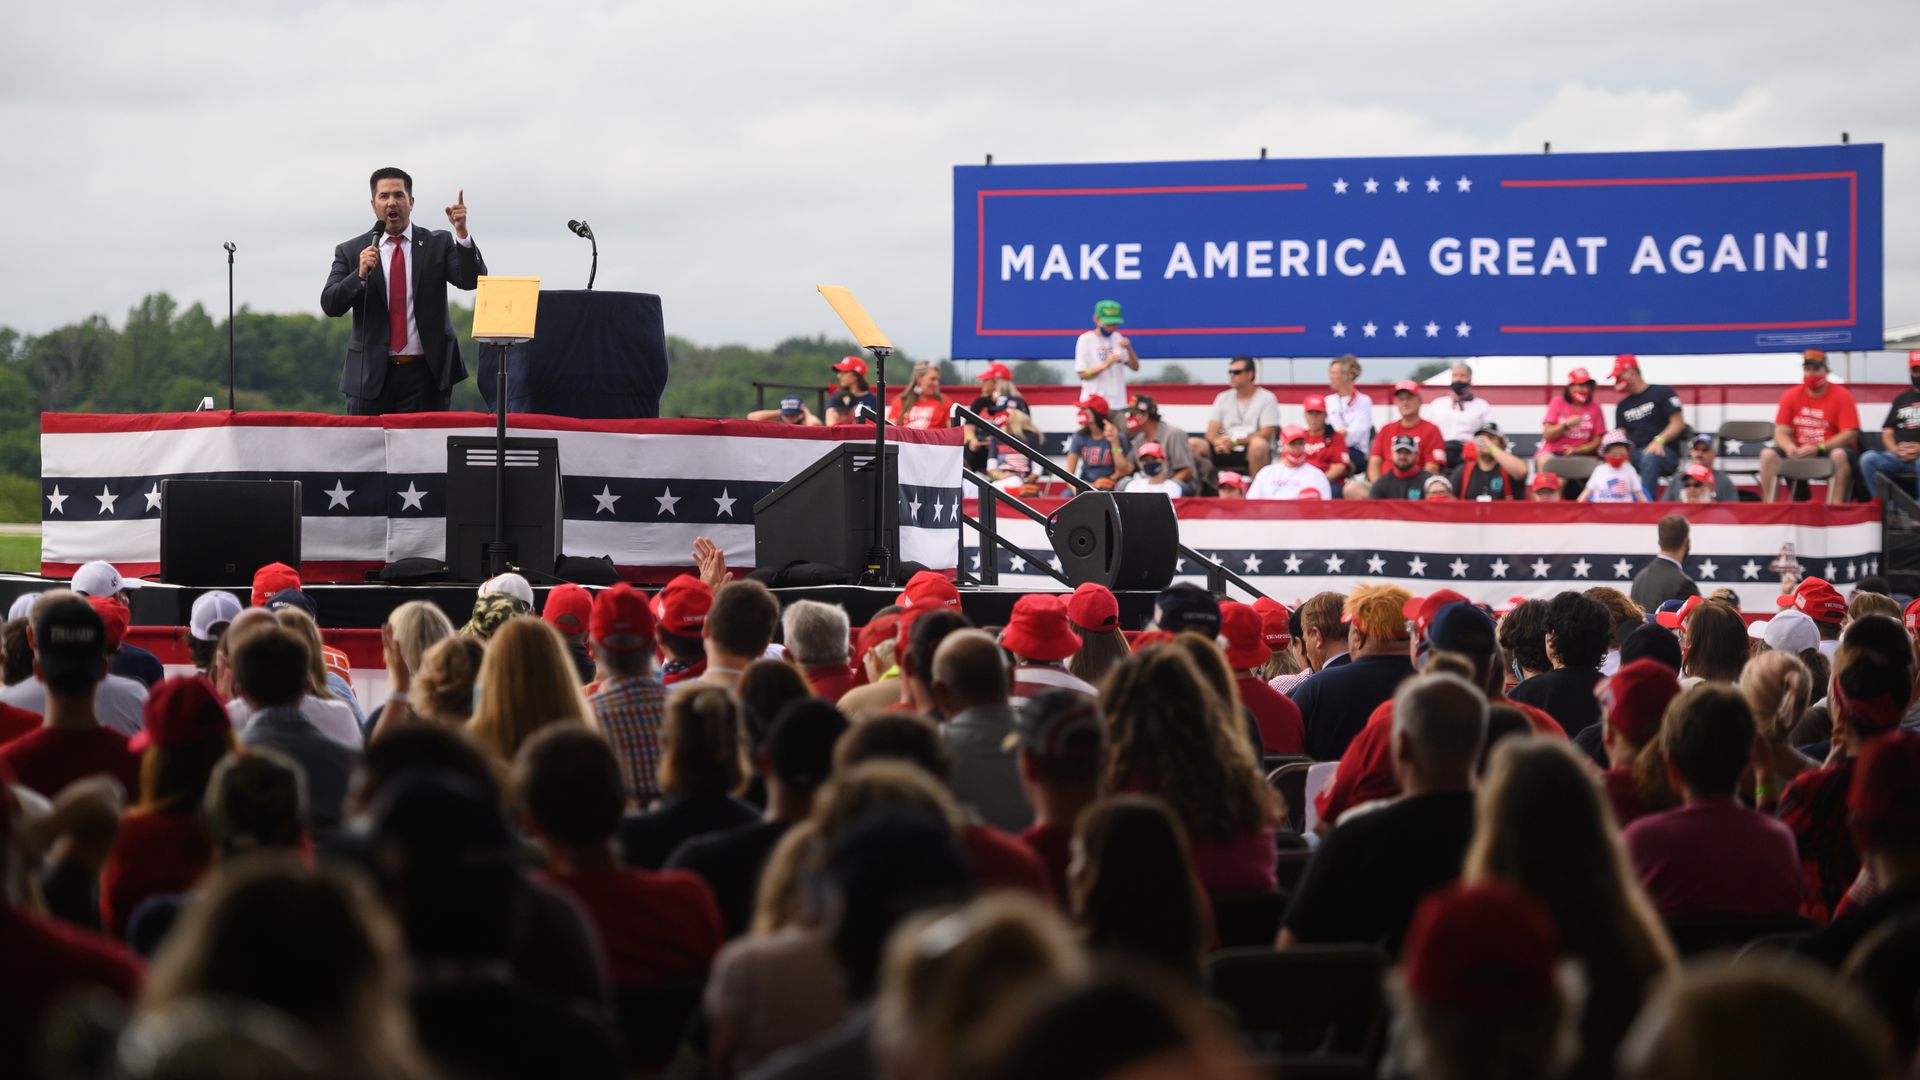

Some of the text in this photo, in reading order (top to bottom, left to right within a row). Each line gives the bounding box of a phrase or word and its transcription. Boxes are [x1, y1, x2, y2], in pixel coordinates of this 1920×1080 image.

[1001, 230, 1828, 282] MAKE AMERICA GREAT AGAIN!
[50, 626, 95, 643] TRUMP
